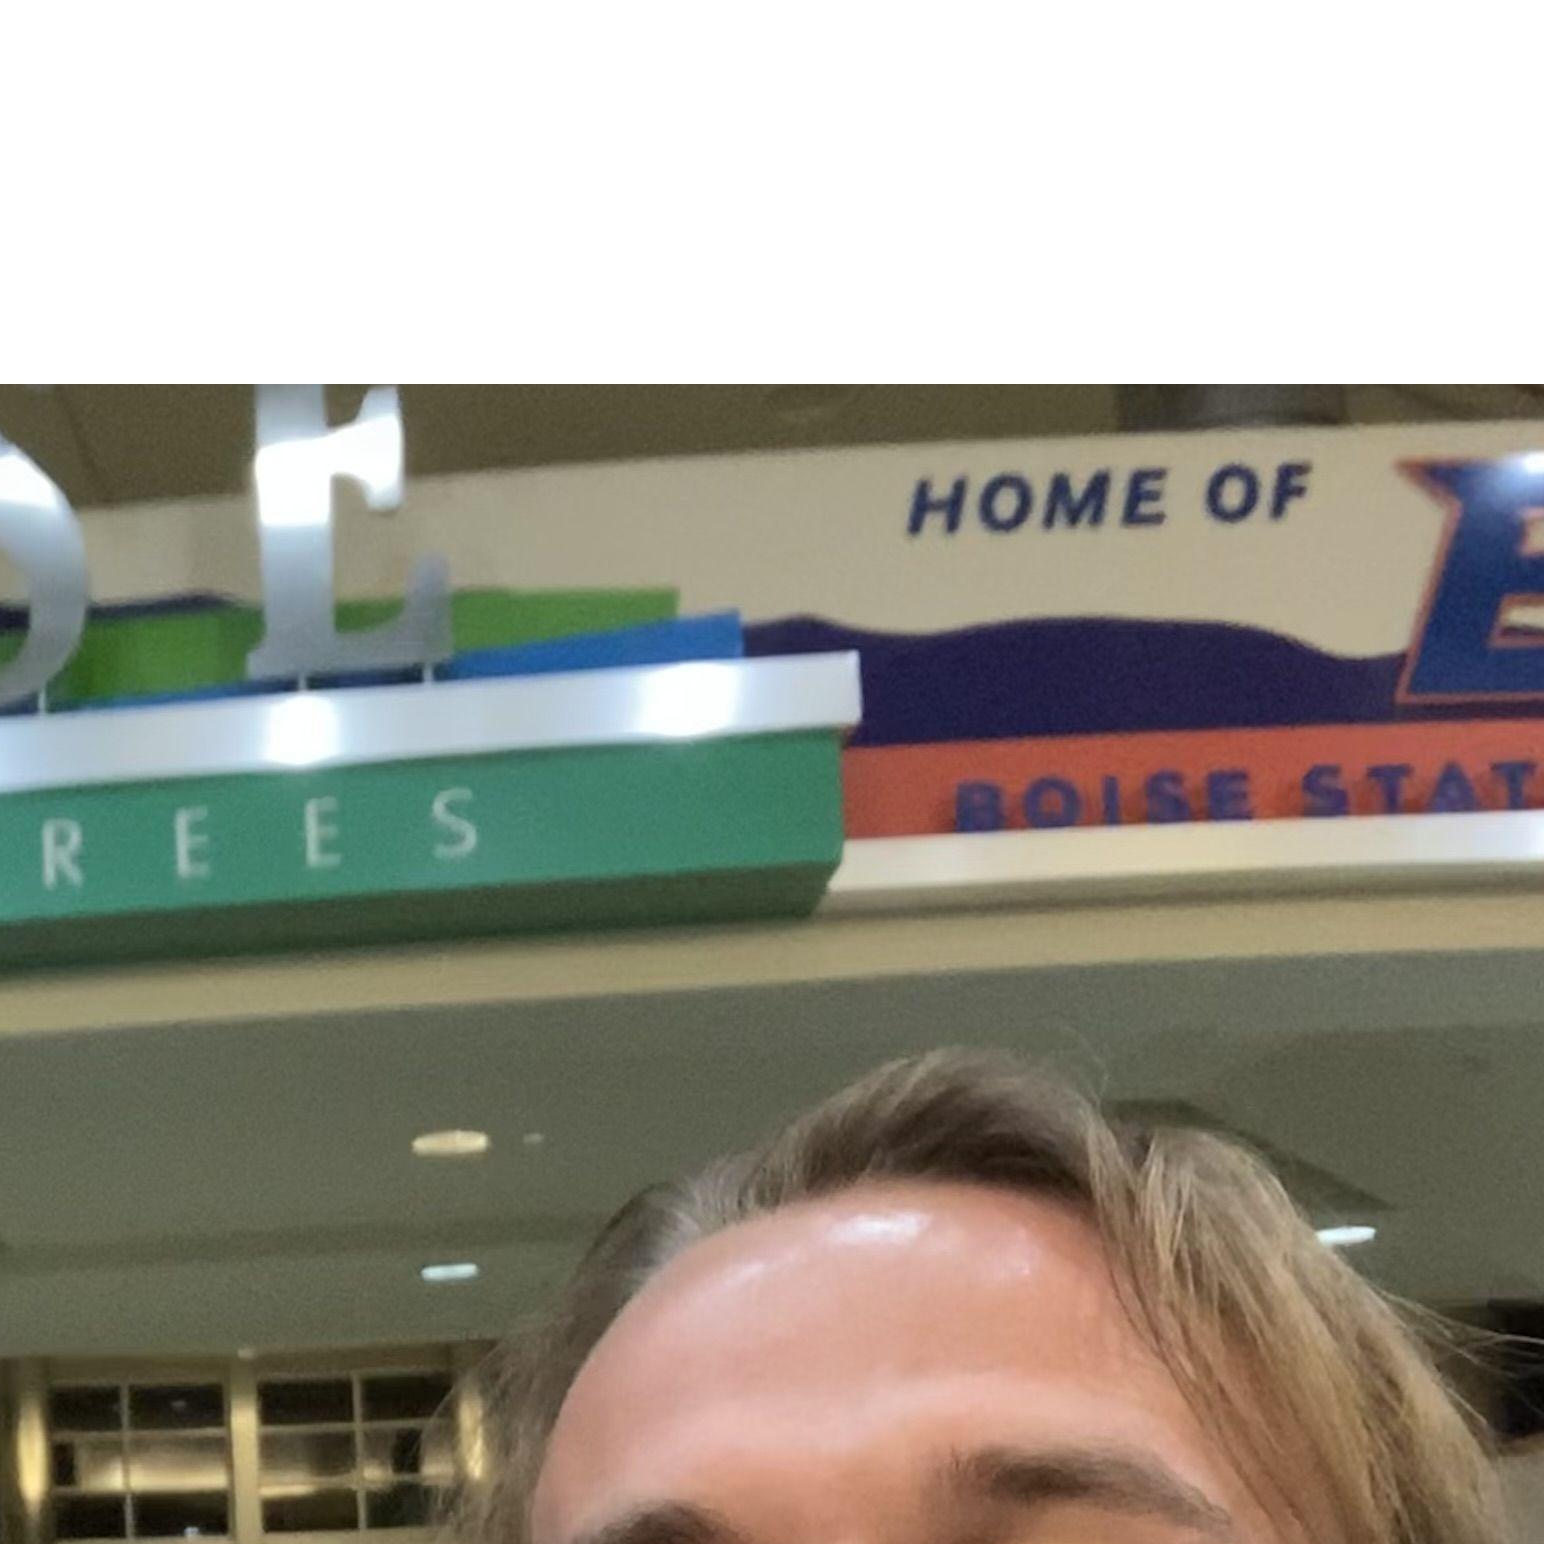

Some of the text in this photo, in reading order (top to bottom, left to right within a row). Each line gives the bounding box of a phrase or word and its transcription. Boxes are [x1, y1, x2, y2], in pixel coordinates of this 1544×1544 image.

[906, 461, 1313, 538] HOME OF
[954, 769, 1252, 834] BOISE
